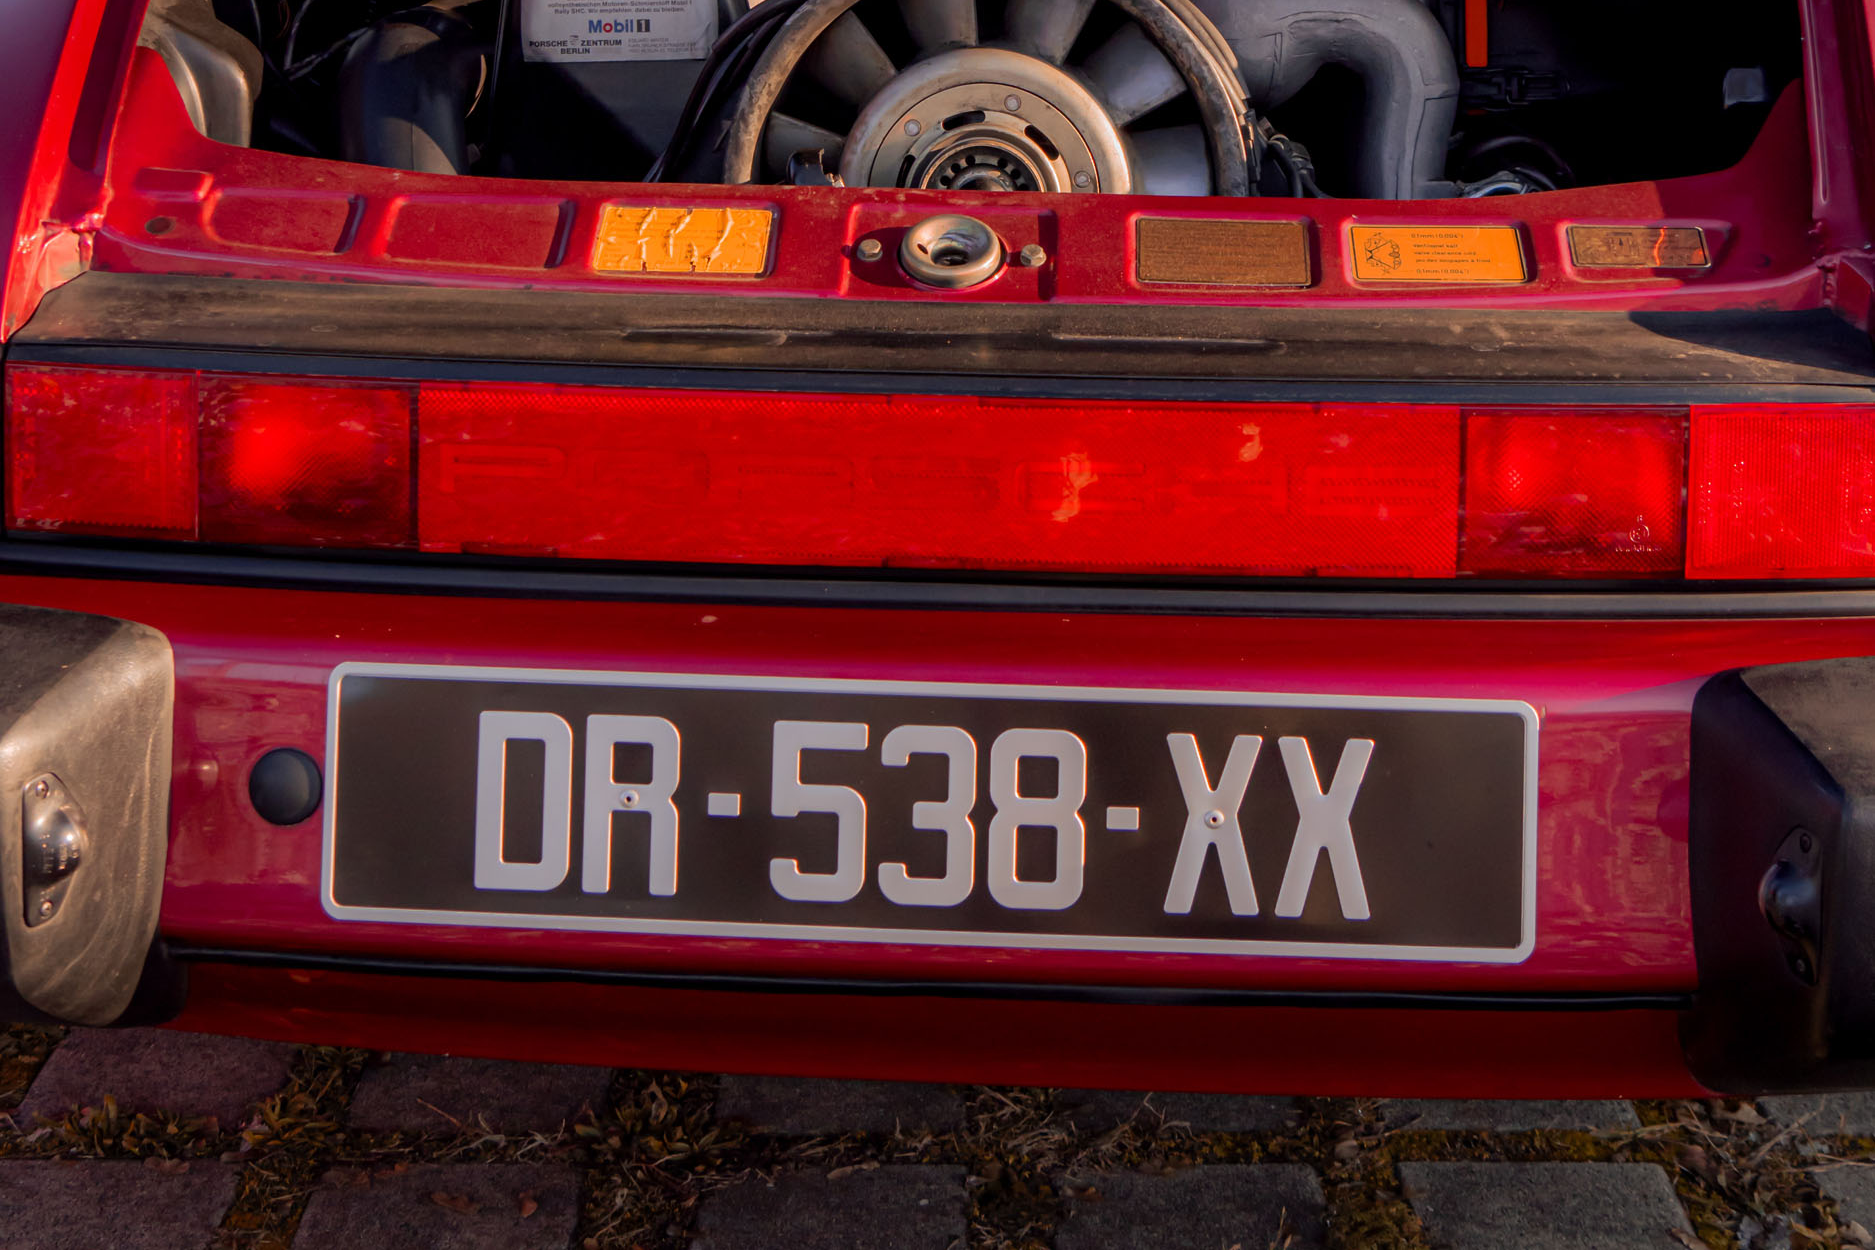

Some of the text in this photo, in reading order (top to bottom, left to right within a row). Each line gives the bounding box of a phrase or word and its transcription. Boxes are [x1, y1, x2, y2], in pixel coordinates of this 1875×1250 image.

[588, 19, 634, 34] Mobil
[529, 39, 623, 48] PORSCHE ZENTRUM
[473, 710, 1375, 922] DR-538-XX
